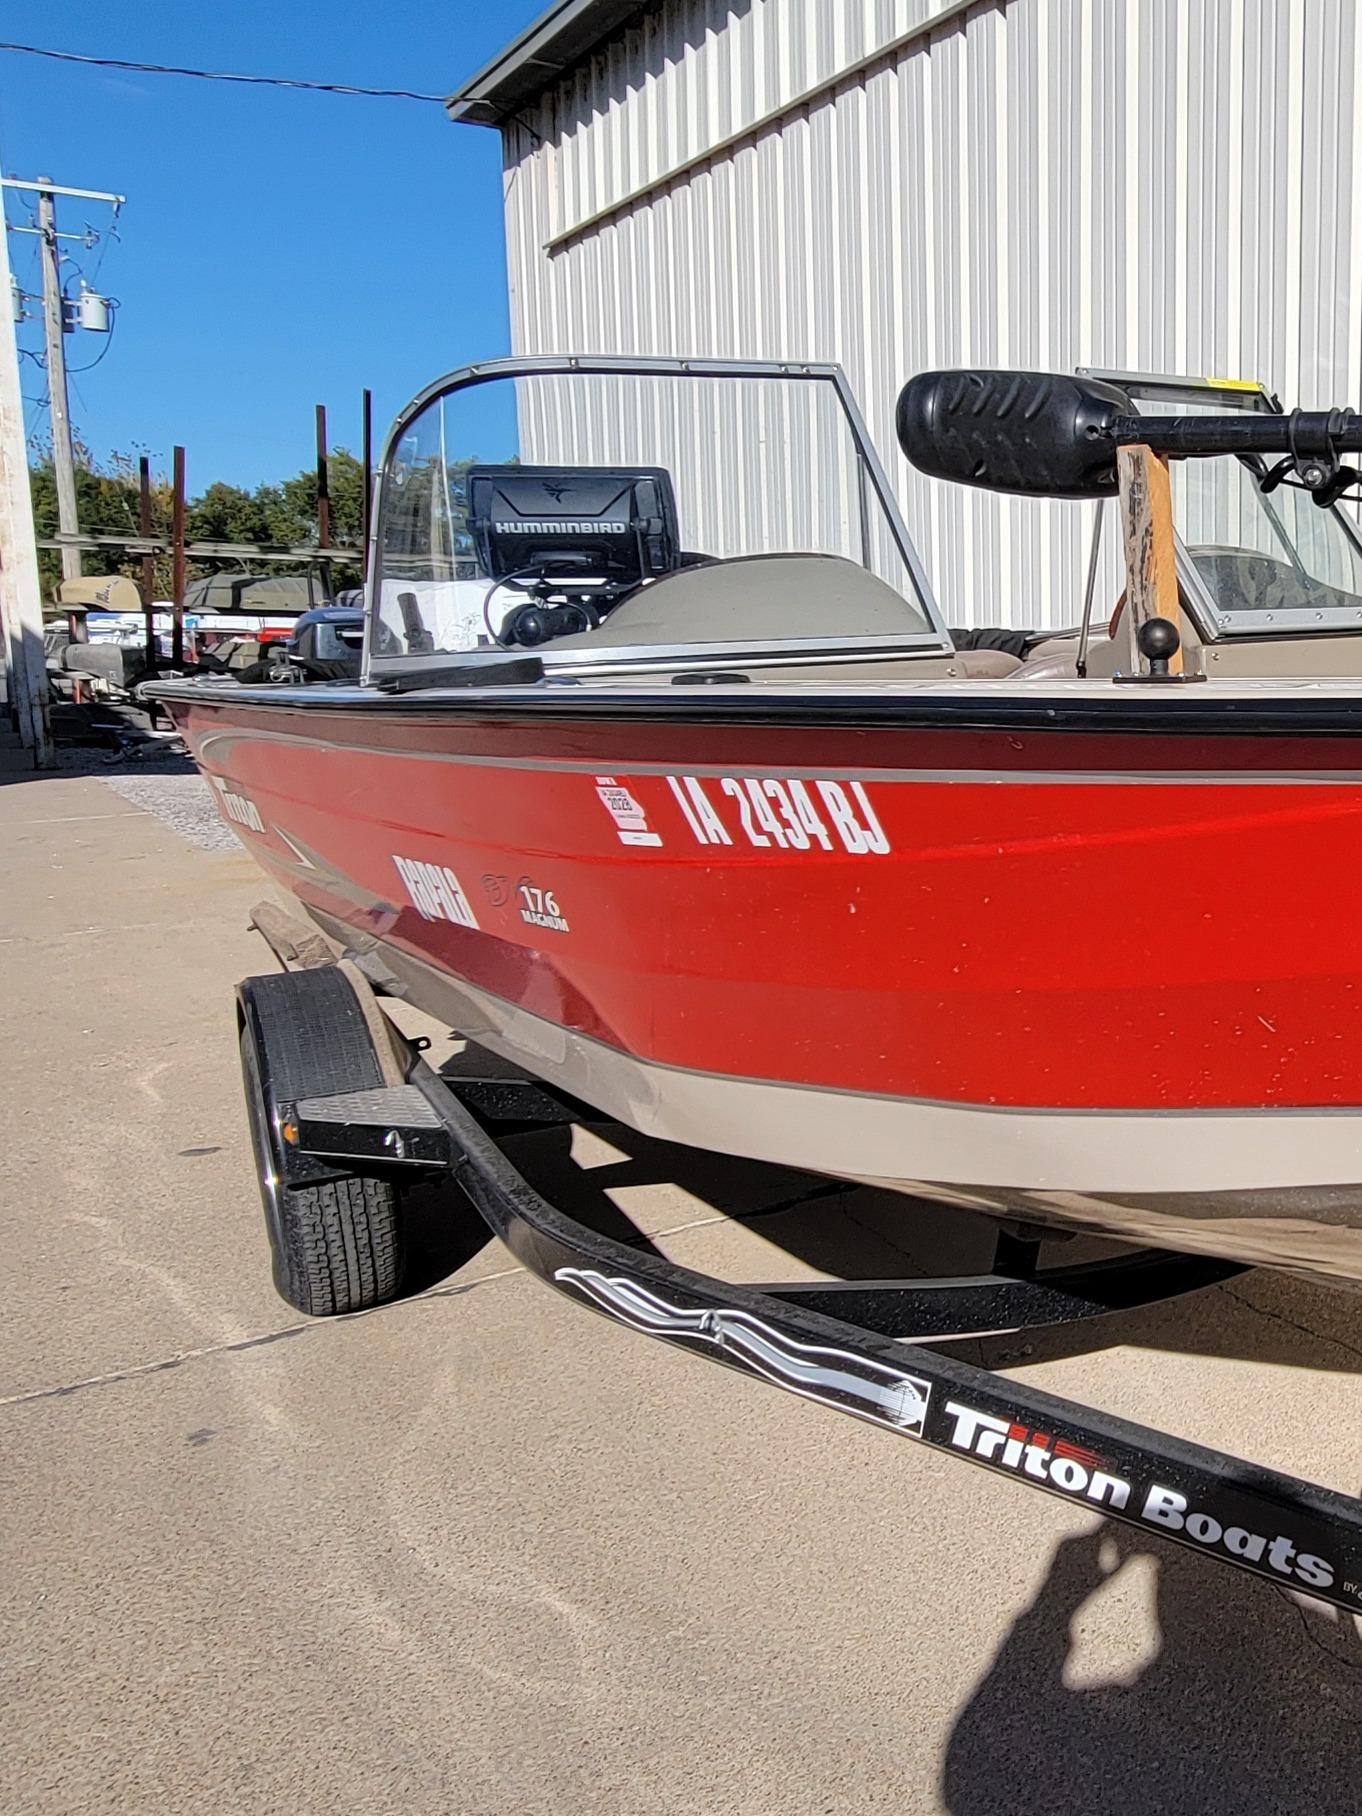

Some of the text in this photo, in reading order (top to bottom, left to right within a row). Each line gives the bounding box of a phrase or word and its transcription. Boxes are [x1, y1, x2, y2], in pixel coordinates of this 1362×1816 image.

[495, 521, 627, 535] HUMMINBIRD
[666, 775, 891, 855] IA 2434 BJ
[519, 885, 560, 917] 176
[945, 1400, 1336, 1589] Triton Boats
